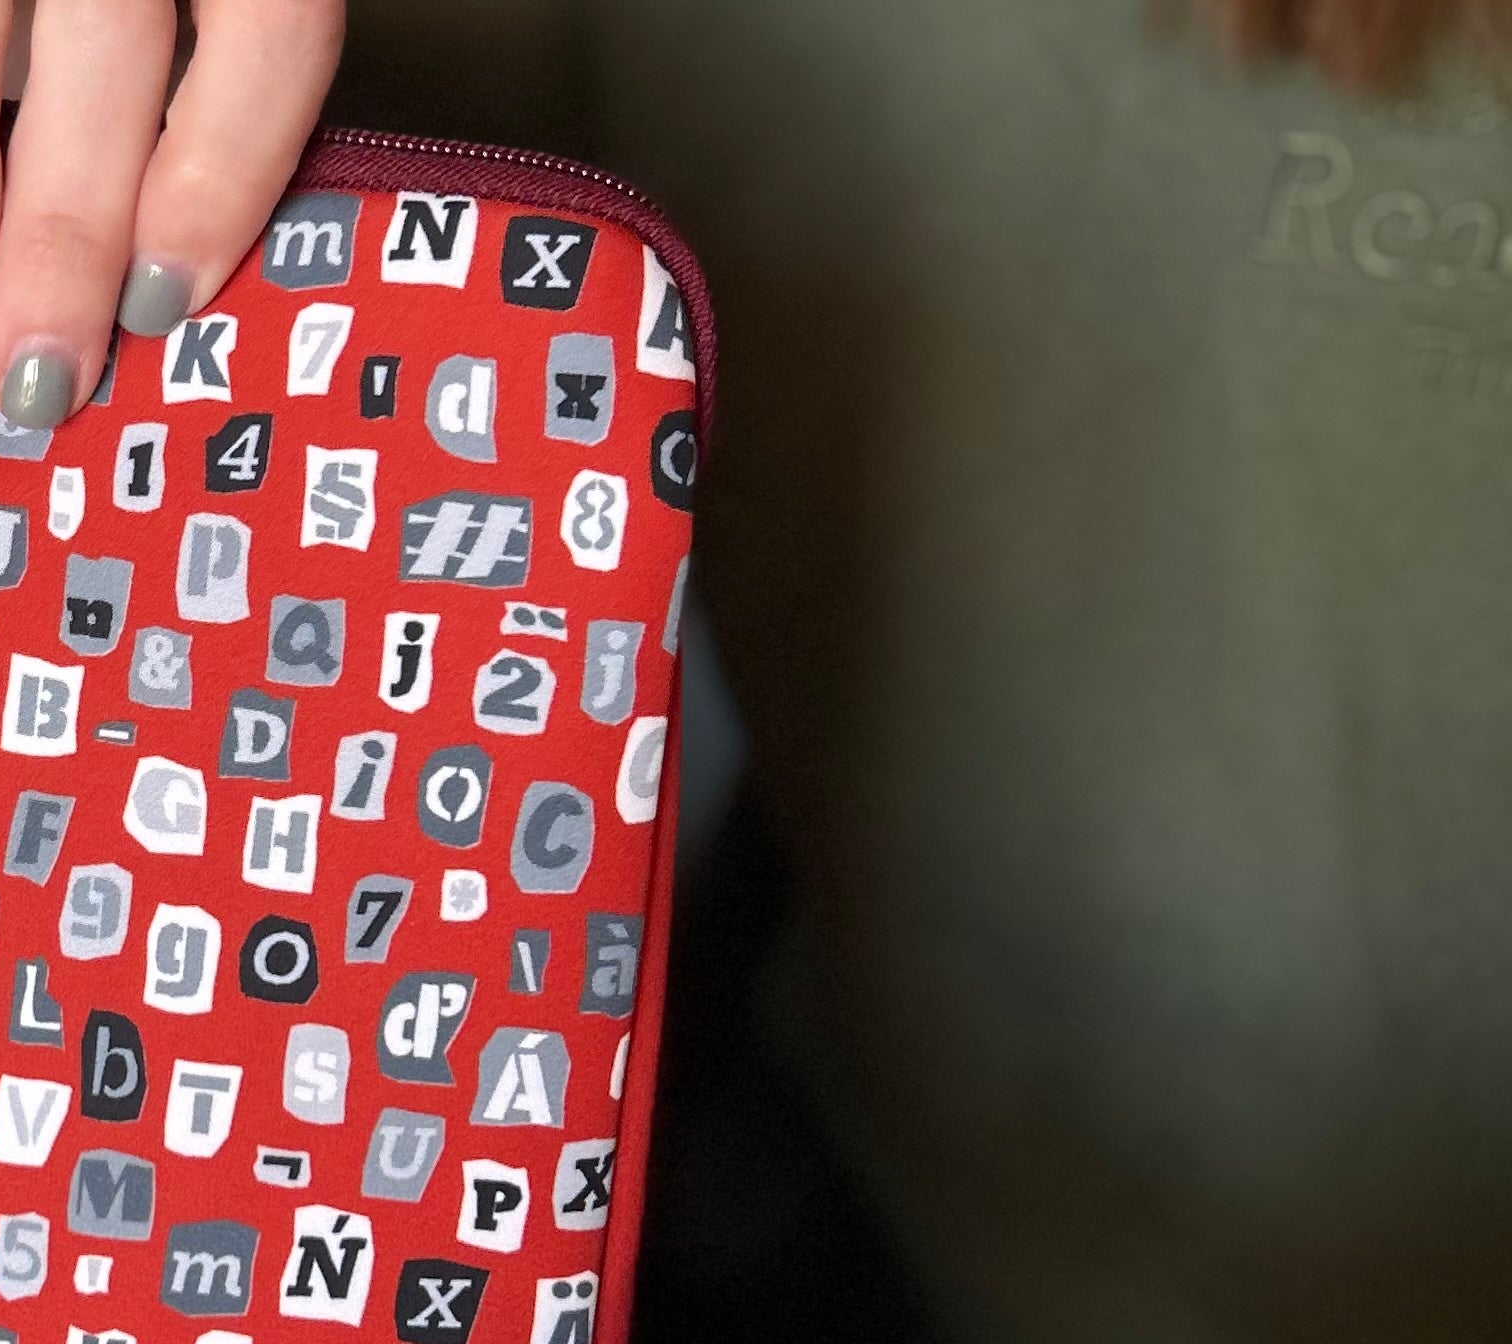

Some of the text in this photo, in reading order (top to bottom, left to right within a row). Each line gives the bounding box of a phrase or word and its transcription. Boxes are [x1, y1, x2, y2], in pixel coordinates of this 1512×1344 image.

[272, 221, 342, 266] m
[170, 320, 232, 388] K
[300, 320, 343, 379] 7
[438, 365, 491, 434] d
[128, 442, 154, 496] 1
[218, 425, 260, 480] 4
[572, 480, 615, 551] 8
[139, 634, 185, 690] &
[272, 603, 338, 675] Q
[390, 621, 424, 697] j
[592, 630, 628, 709] j
[17, 674, 70, 739] B
[479, 657, 542, 721] 2
[234, 708, 286, 763] D
[14, 799, 61, 864] F
[132, 768, 201, 835] G
[523, 793, 584, 869] C
[250, 807, 309, 873] H
[20, 965, 59, 1030] L
[92, 1026, 138, 1098] b
[179, 1073, 230, 1135] T
[76, 1159, 151, 1223] M
[474, 1179, 522, 1231] P
[562, 1152, 610, 1213] X
[2, 1219, 42, 1282] 5
[171, 1251, 241, 1296] m
